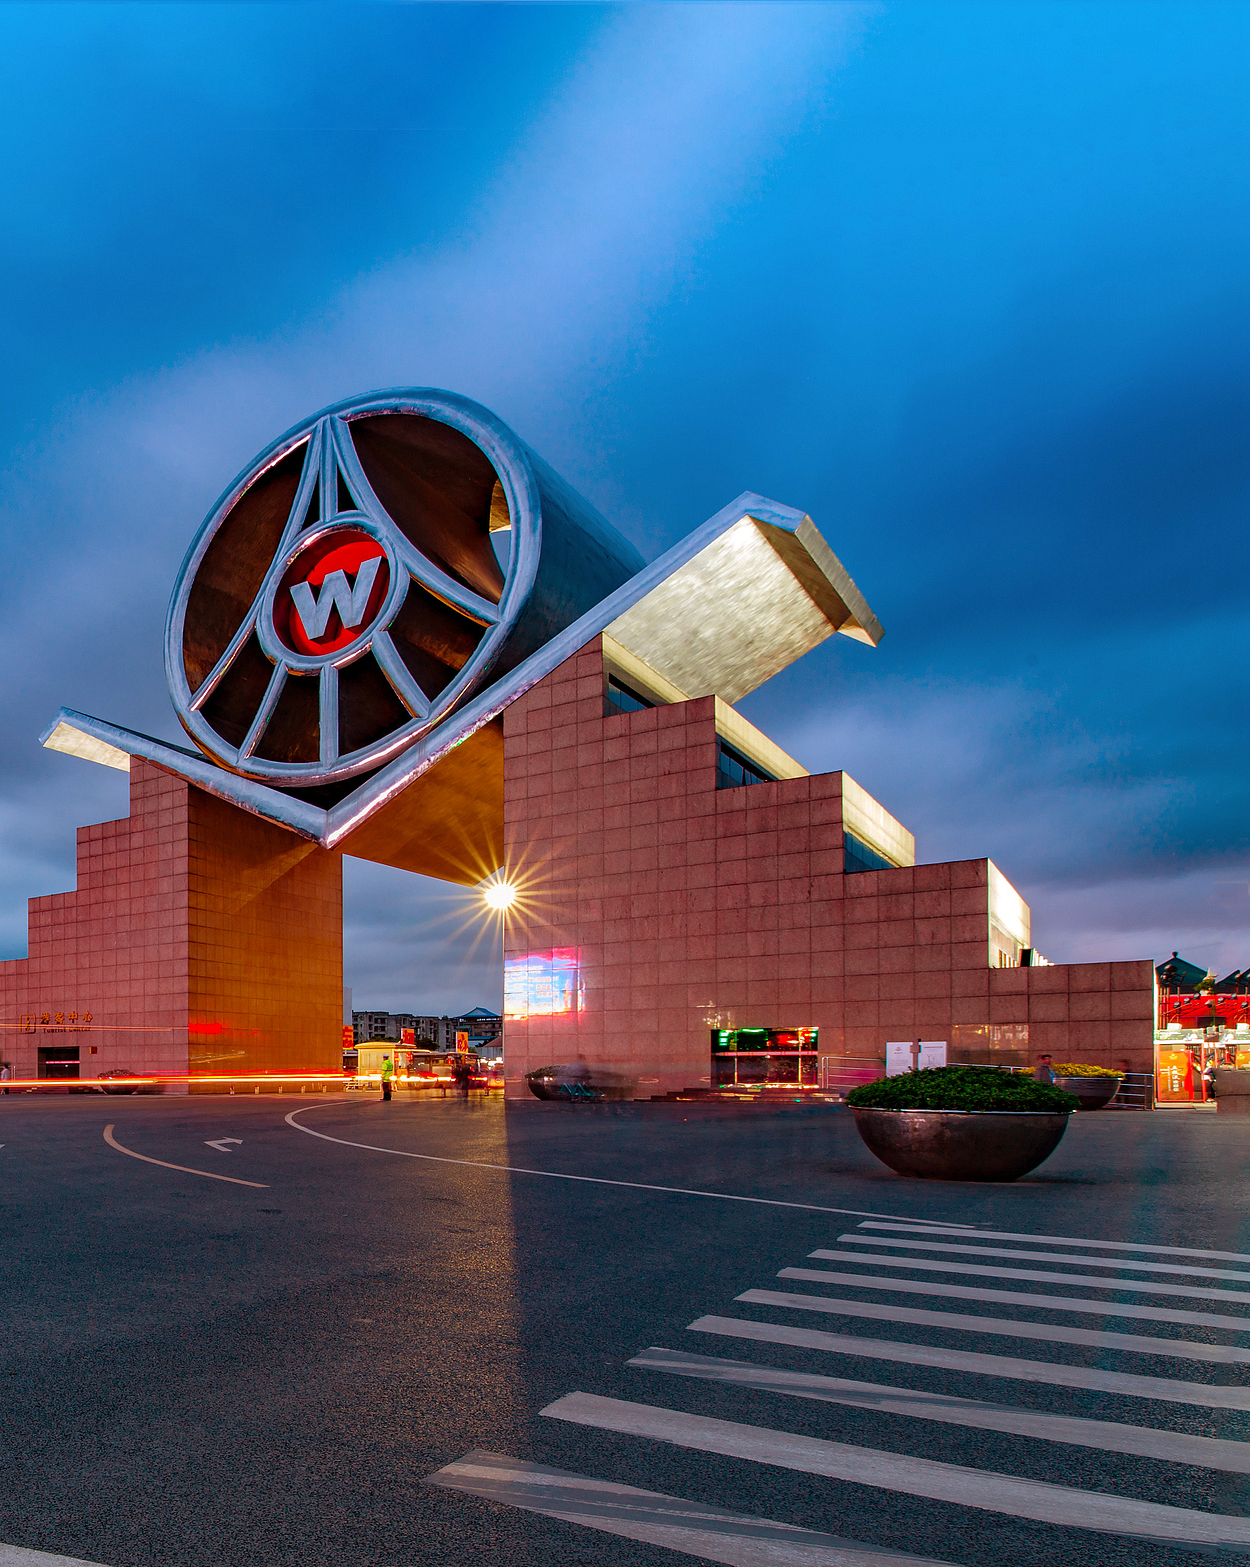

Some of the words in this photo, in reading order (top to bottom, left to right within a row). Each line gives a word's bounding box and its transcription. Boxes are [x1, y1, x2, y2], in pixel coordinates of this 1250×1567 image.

[290, 555, 382, 640] W
[40, 1010, 93, 1024] 游客中心
